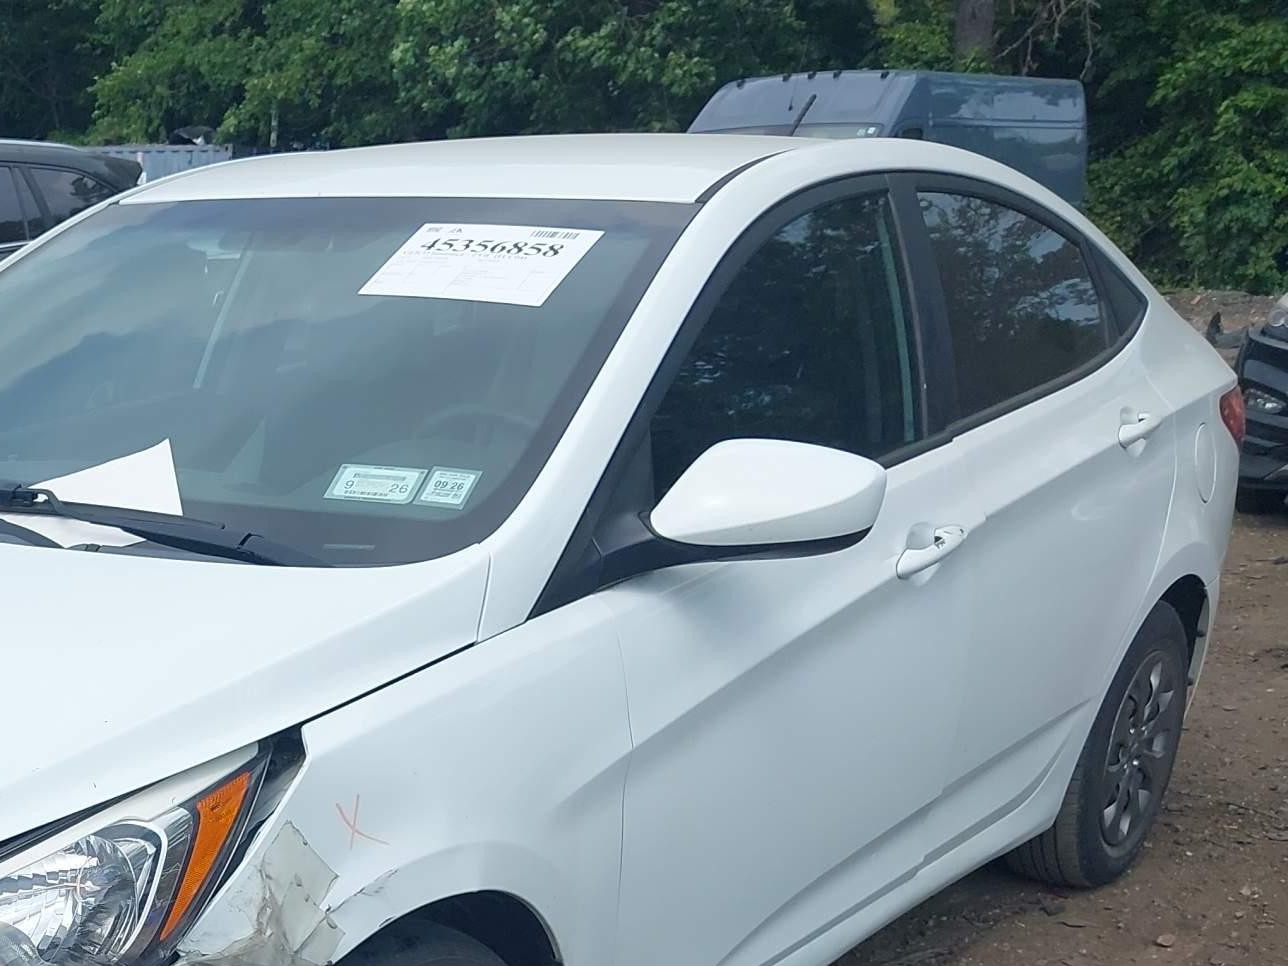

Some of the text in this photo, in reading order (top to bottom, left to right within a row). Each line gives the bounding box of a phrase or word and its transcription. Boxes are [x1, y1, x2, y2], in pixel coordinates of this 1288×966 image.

[420, 237, 565, 258] 45356858
[343, 480, 354, 490] 9
[387, 483, 409, 494] 26
[433, 480, 465, 491] 09 26
